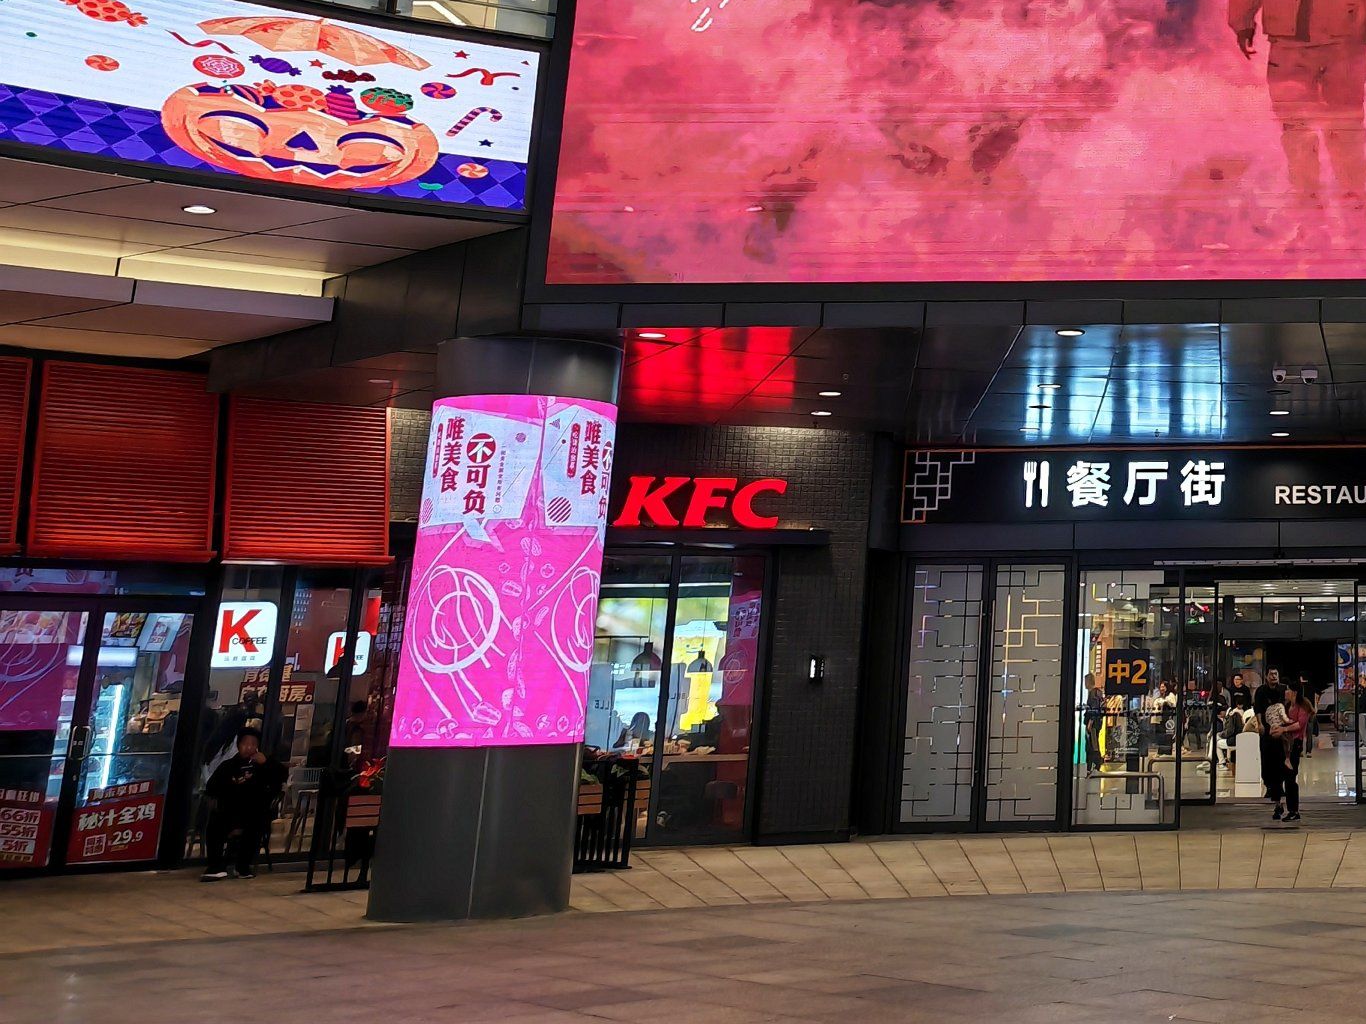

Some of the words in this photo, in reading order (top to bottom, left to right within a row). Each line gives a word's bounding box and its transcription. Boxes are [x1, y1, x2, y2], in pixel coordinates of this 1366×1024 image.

[440, 416, 466, 493] 唯美食
[462, 435, 495, 515] 不可负
[579, 420, 603, 495] 唯美食
[613, 476, 788, 529] KFC
[1066, 459, 1226, 507] 餐厅街
[232, 636, 268, 645] COFFEE
[1108, 659, 1148, 685] 中2
[112, 829, 144, 846] 29.9
